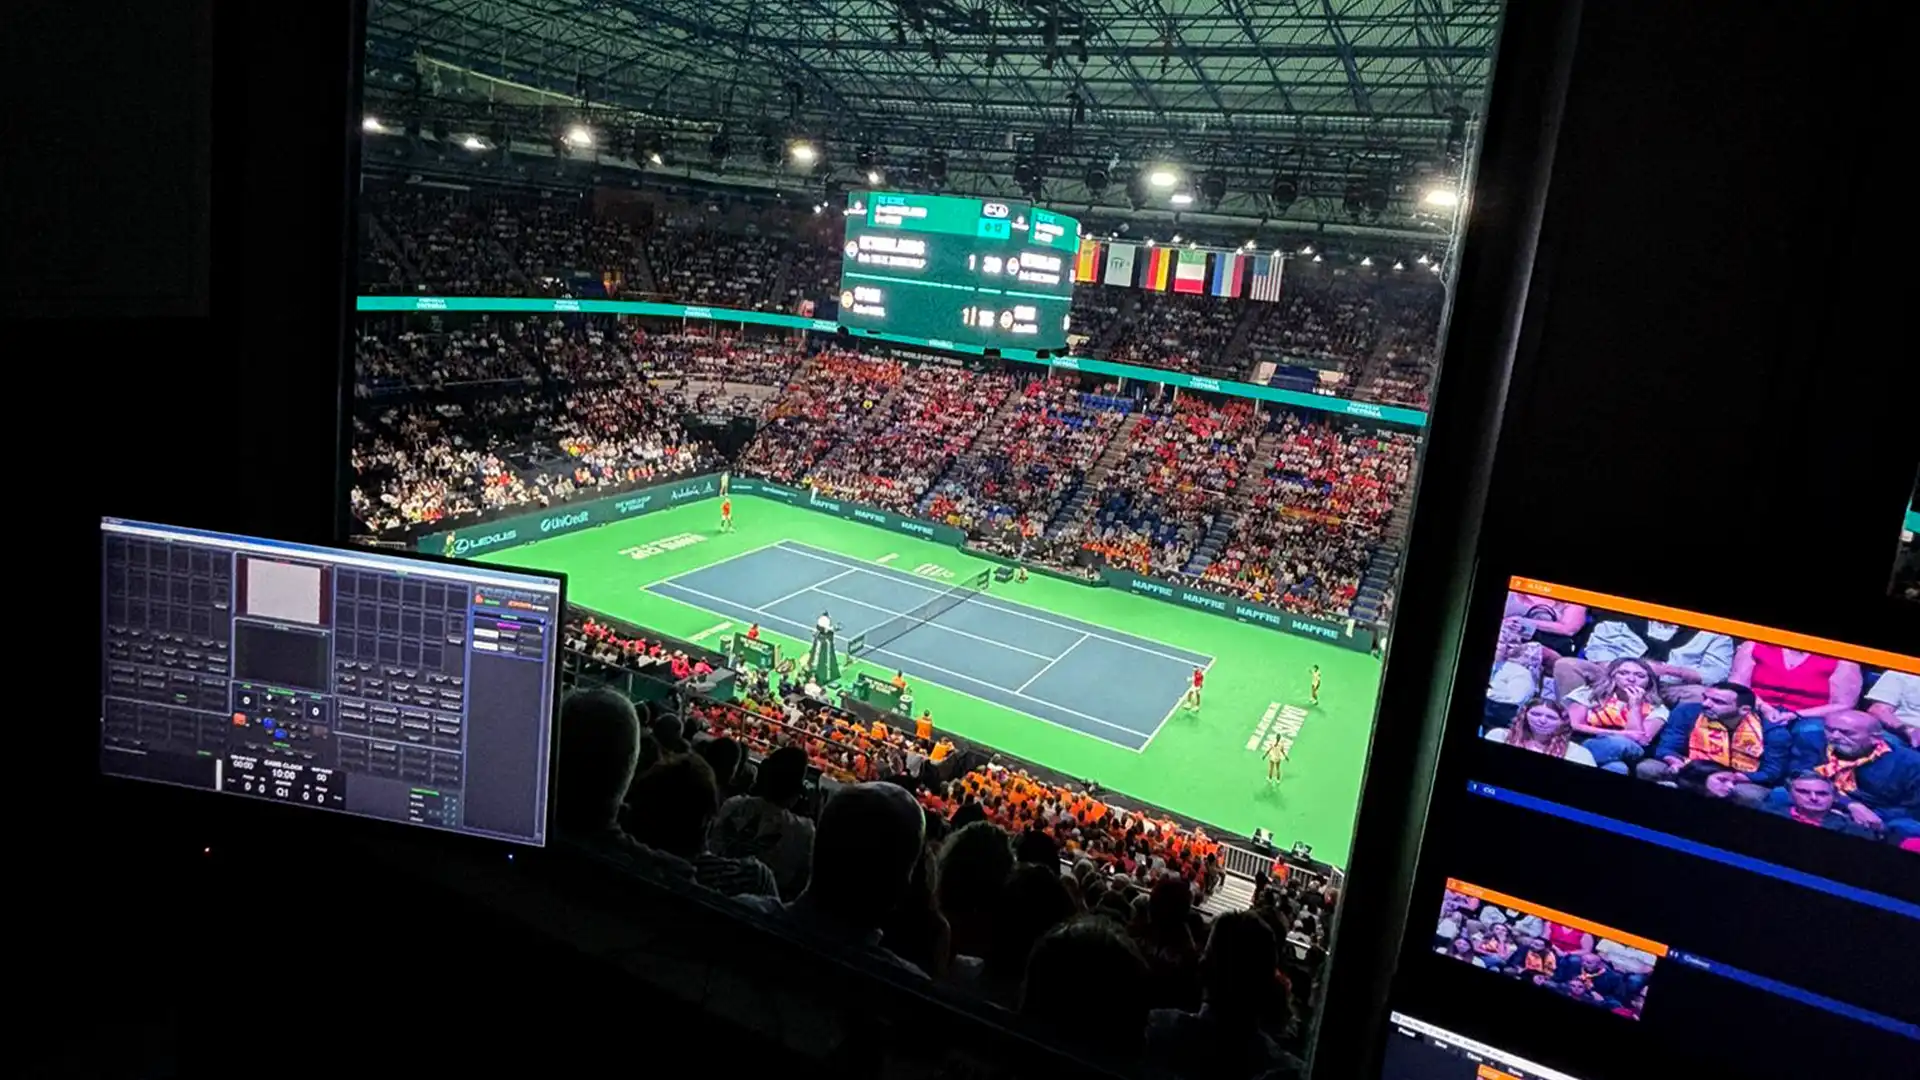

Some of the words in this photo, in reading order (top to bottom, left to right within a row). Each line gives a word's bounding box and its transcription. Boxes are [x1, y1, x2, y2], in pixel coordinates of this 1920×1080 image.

[968, 254, 976, 271] 1
[470, 530, 517, 547] LEXUS
[1132, 579, 1173, 597] MAPFRE
[1183, 592, 1226, 611] MAPFRE
[1236, 606, 1281, 625] MAPFRE
[1292, 619, 1338, 640] MAPFRE
[275, 787, 289, 798] Q1
